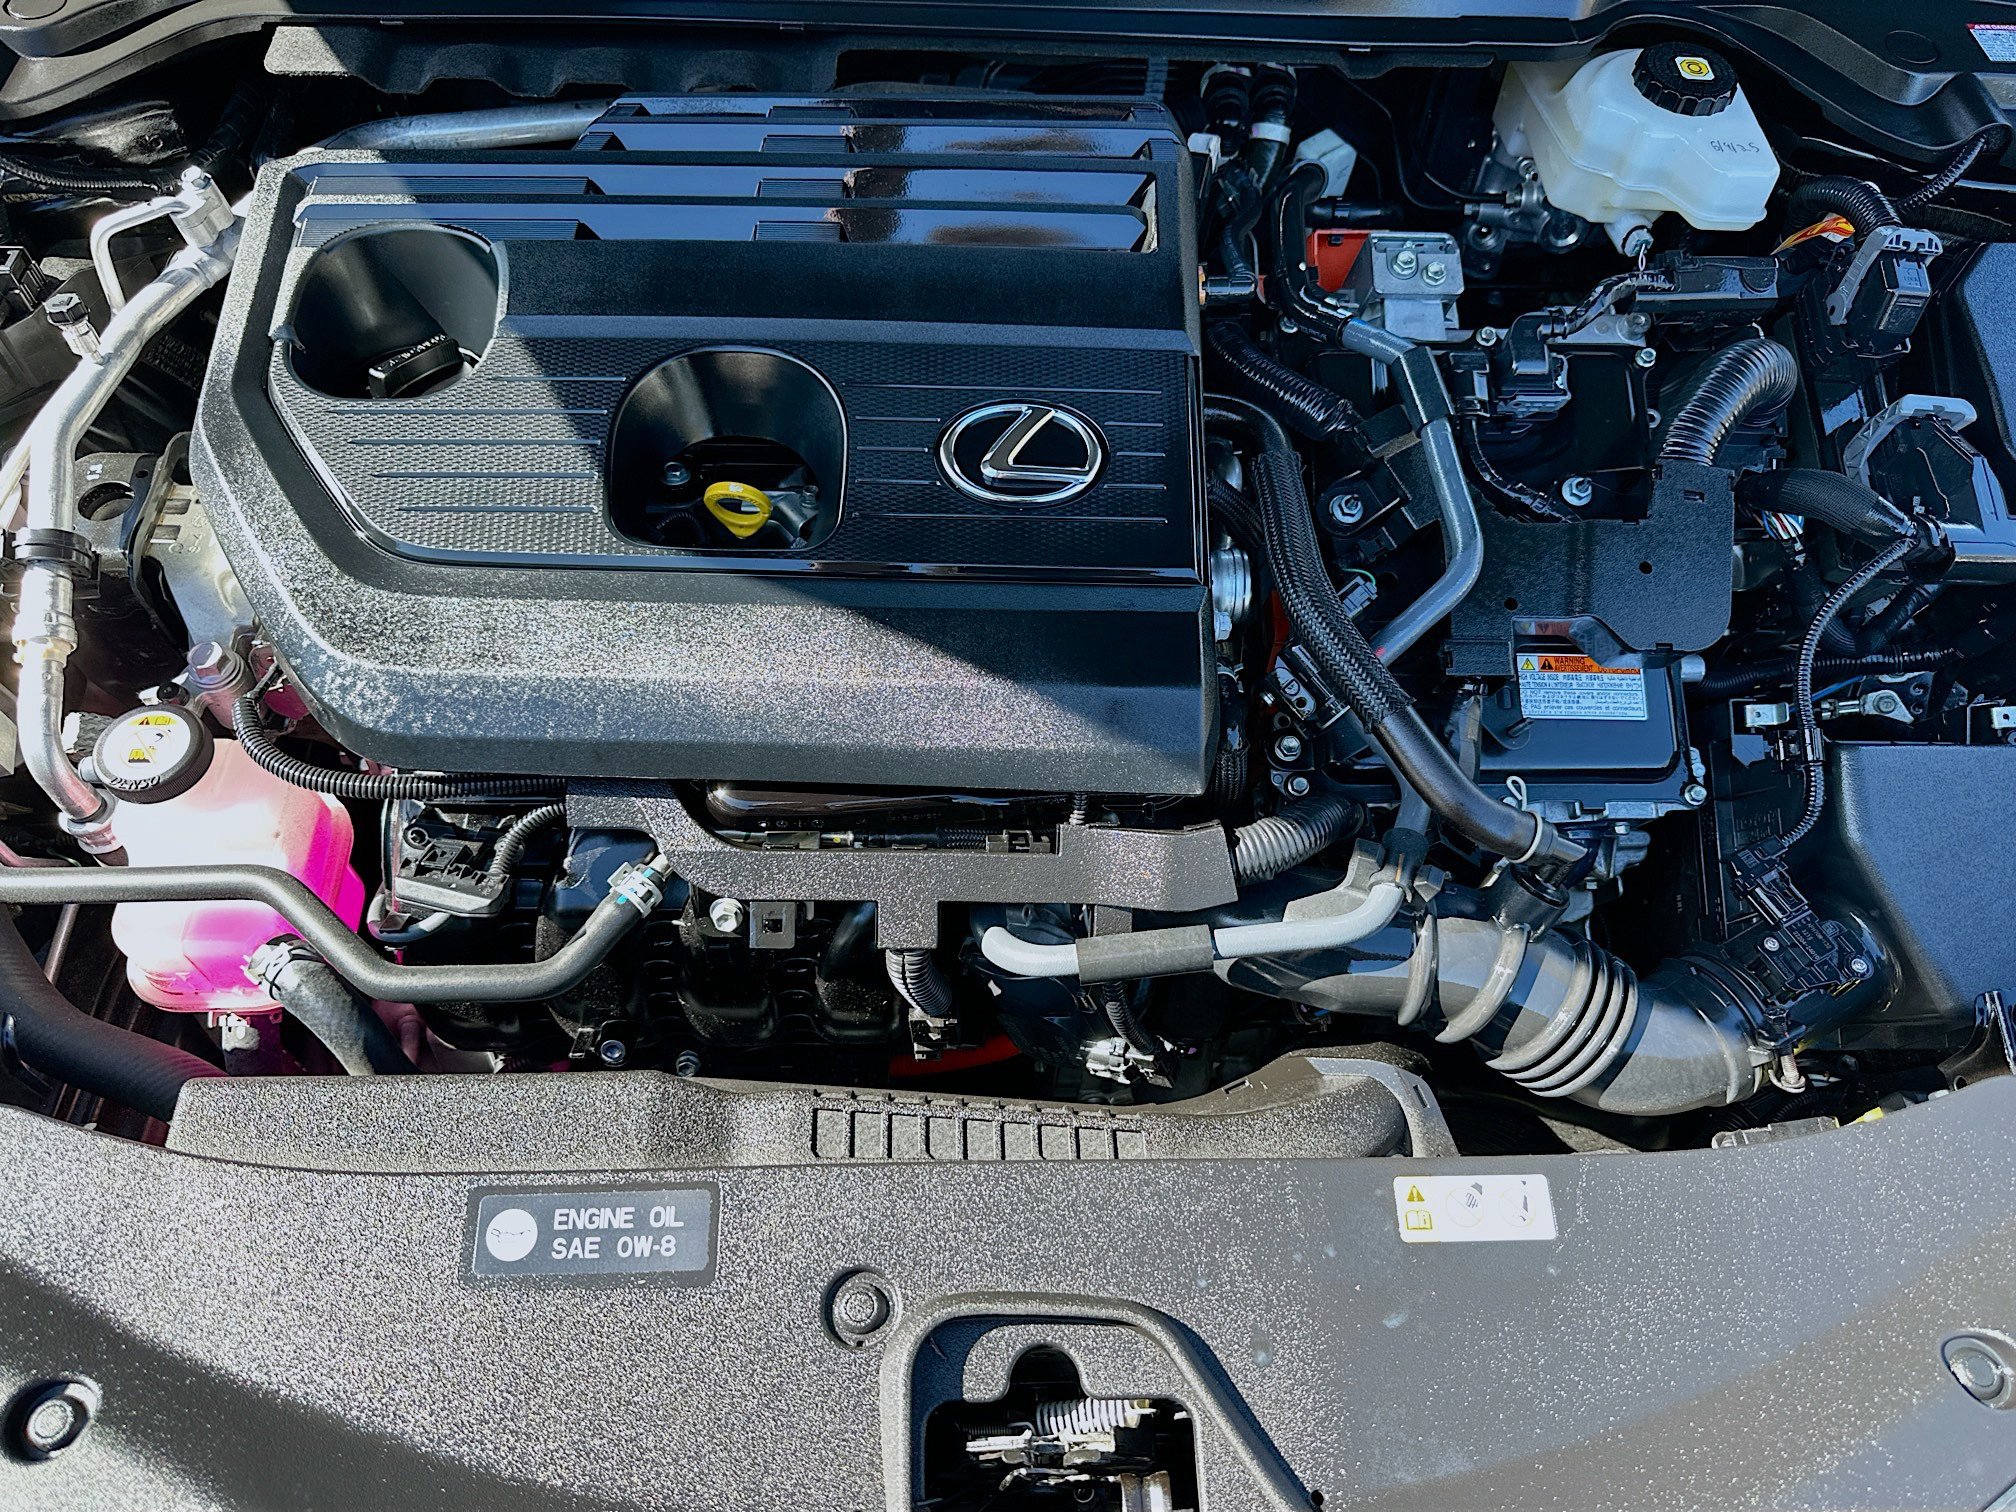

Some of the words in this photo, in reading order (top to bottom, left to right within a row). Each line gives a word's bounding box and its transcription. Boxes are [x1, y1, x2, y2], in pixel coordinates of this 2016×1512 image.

[1554, 657, 1585, 665] WARNING
[110, 776, 160, 790] DENSO
[553, 1207, 635, 1230] ENGINE
[650, 1206, 684, 1228] OIL
[551, 1237, 601, 1259] SAE
